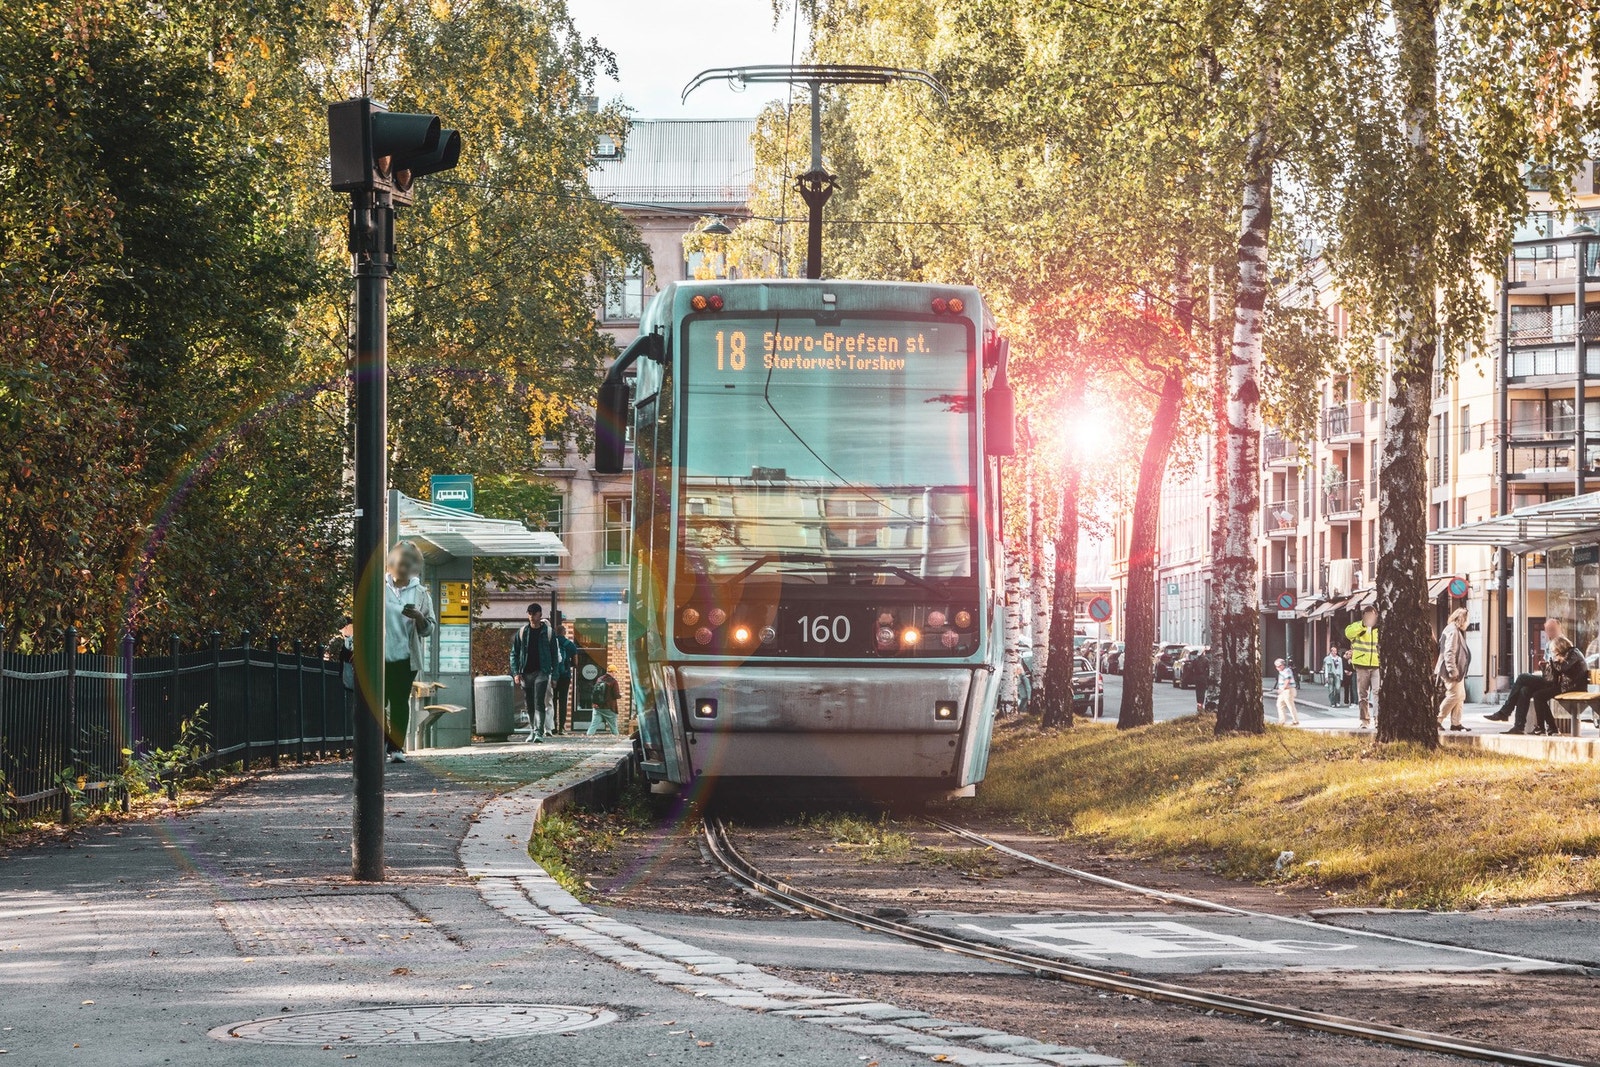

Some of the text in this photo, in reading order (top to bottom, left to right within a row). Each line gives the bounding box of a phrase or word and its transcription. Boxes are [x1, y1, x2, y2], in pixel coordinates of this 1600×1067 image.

[715, 331, 746, 371] 18
[763, 332, 930, 352] Storo-Grefsen st.
[763, 353, 905, 370] Stortorvet-Torshov
[797, 615, 851, 643] 160
